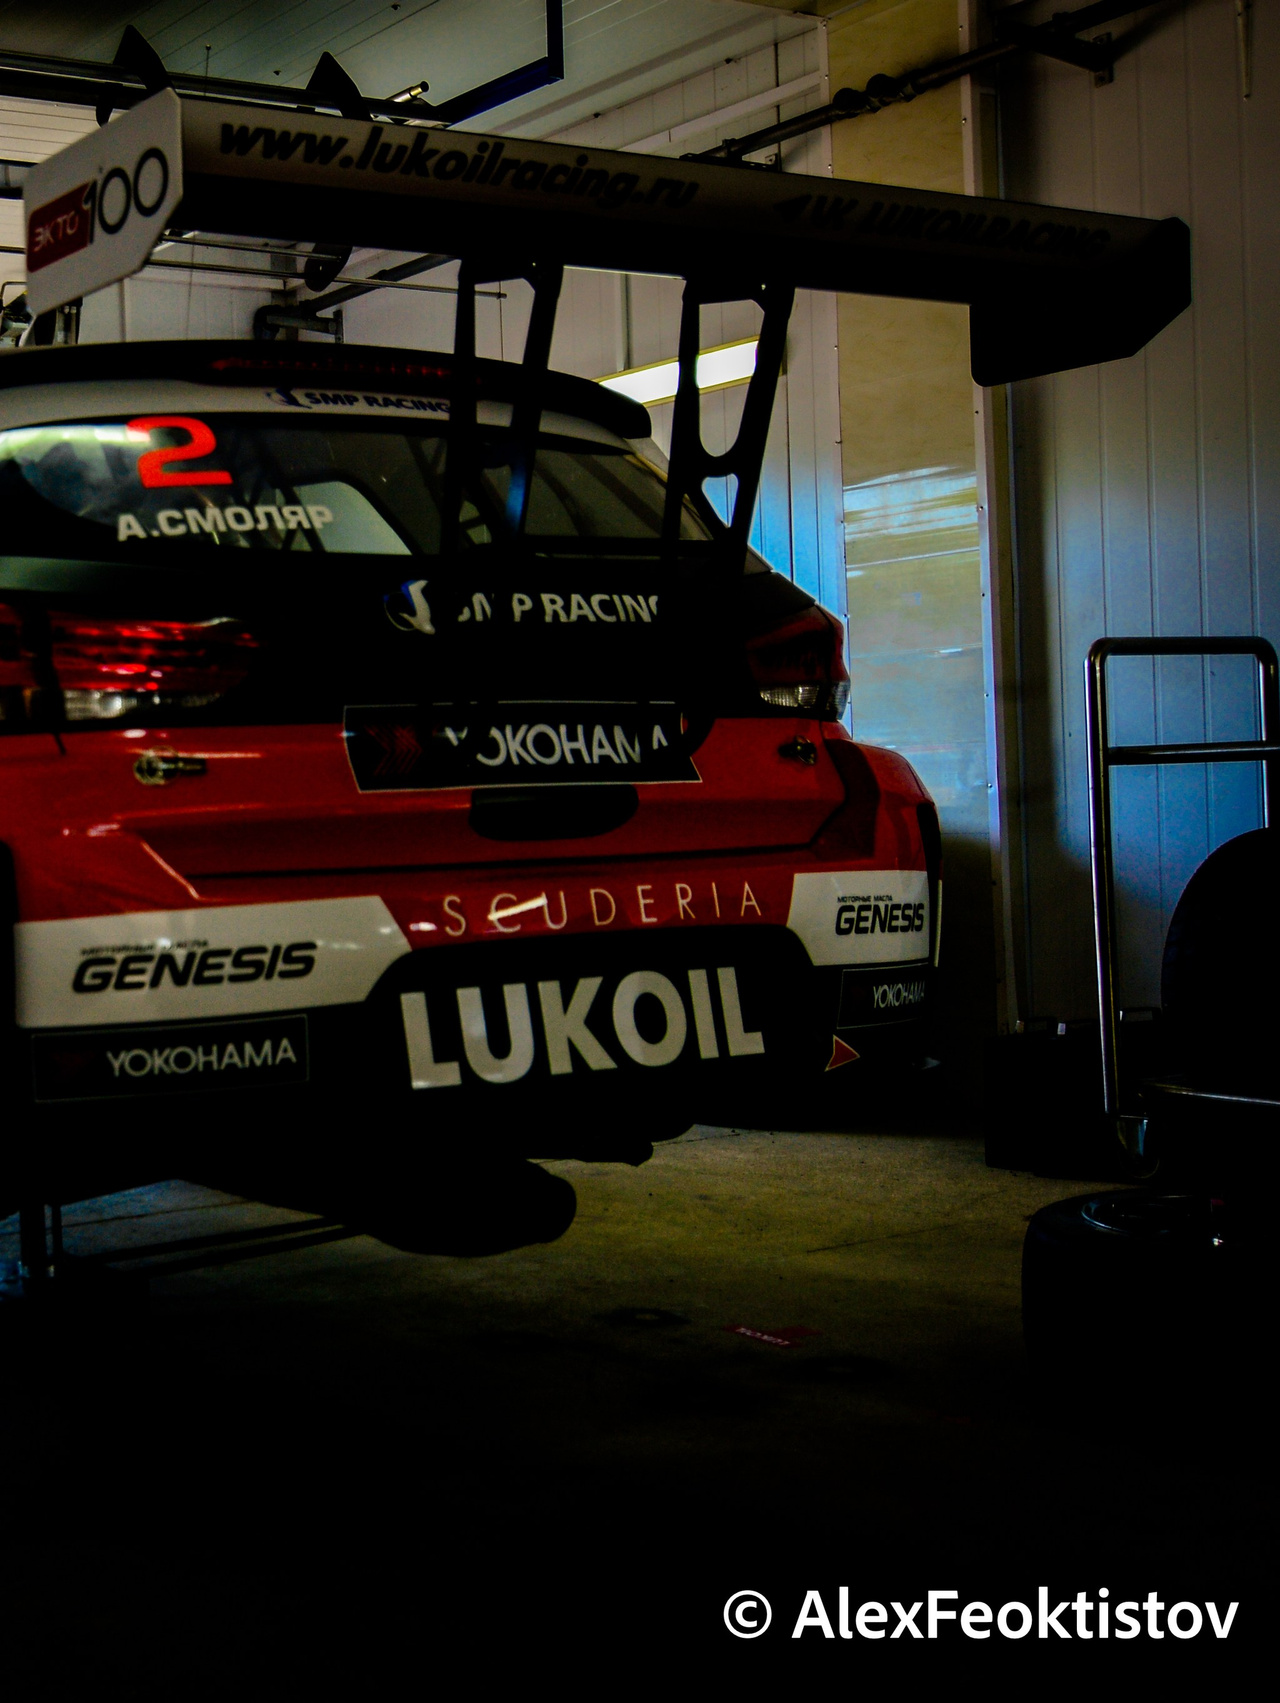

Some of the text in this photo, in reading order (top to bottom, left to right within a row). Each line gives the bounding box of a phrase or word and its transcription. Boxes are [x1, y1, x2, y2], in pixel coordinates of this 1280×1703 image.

[220, 122, 700, 210] www.lukoilracing.ru
[81, 148, 169, 244] 100
[855, 201, 1112, 261] LUKOILRACING
[304, 391, 451, 413] SMP RACING
[126, 414, 234, 490] 2
[443, 881, 762, 938] SCUDERIA
[836, 903, 924, 935] GENESIS
[73, 943, 317, 993] GENESIS
[399, 965, 766, 1090] LUKOIL
[106, 1037, 297, 1078] YOKOHAMA
